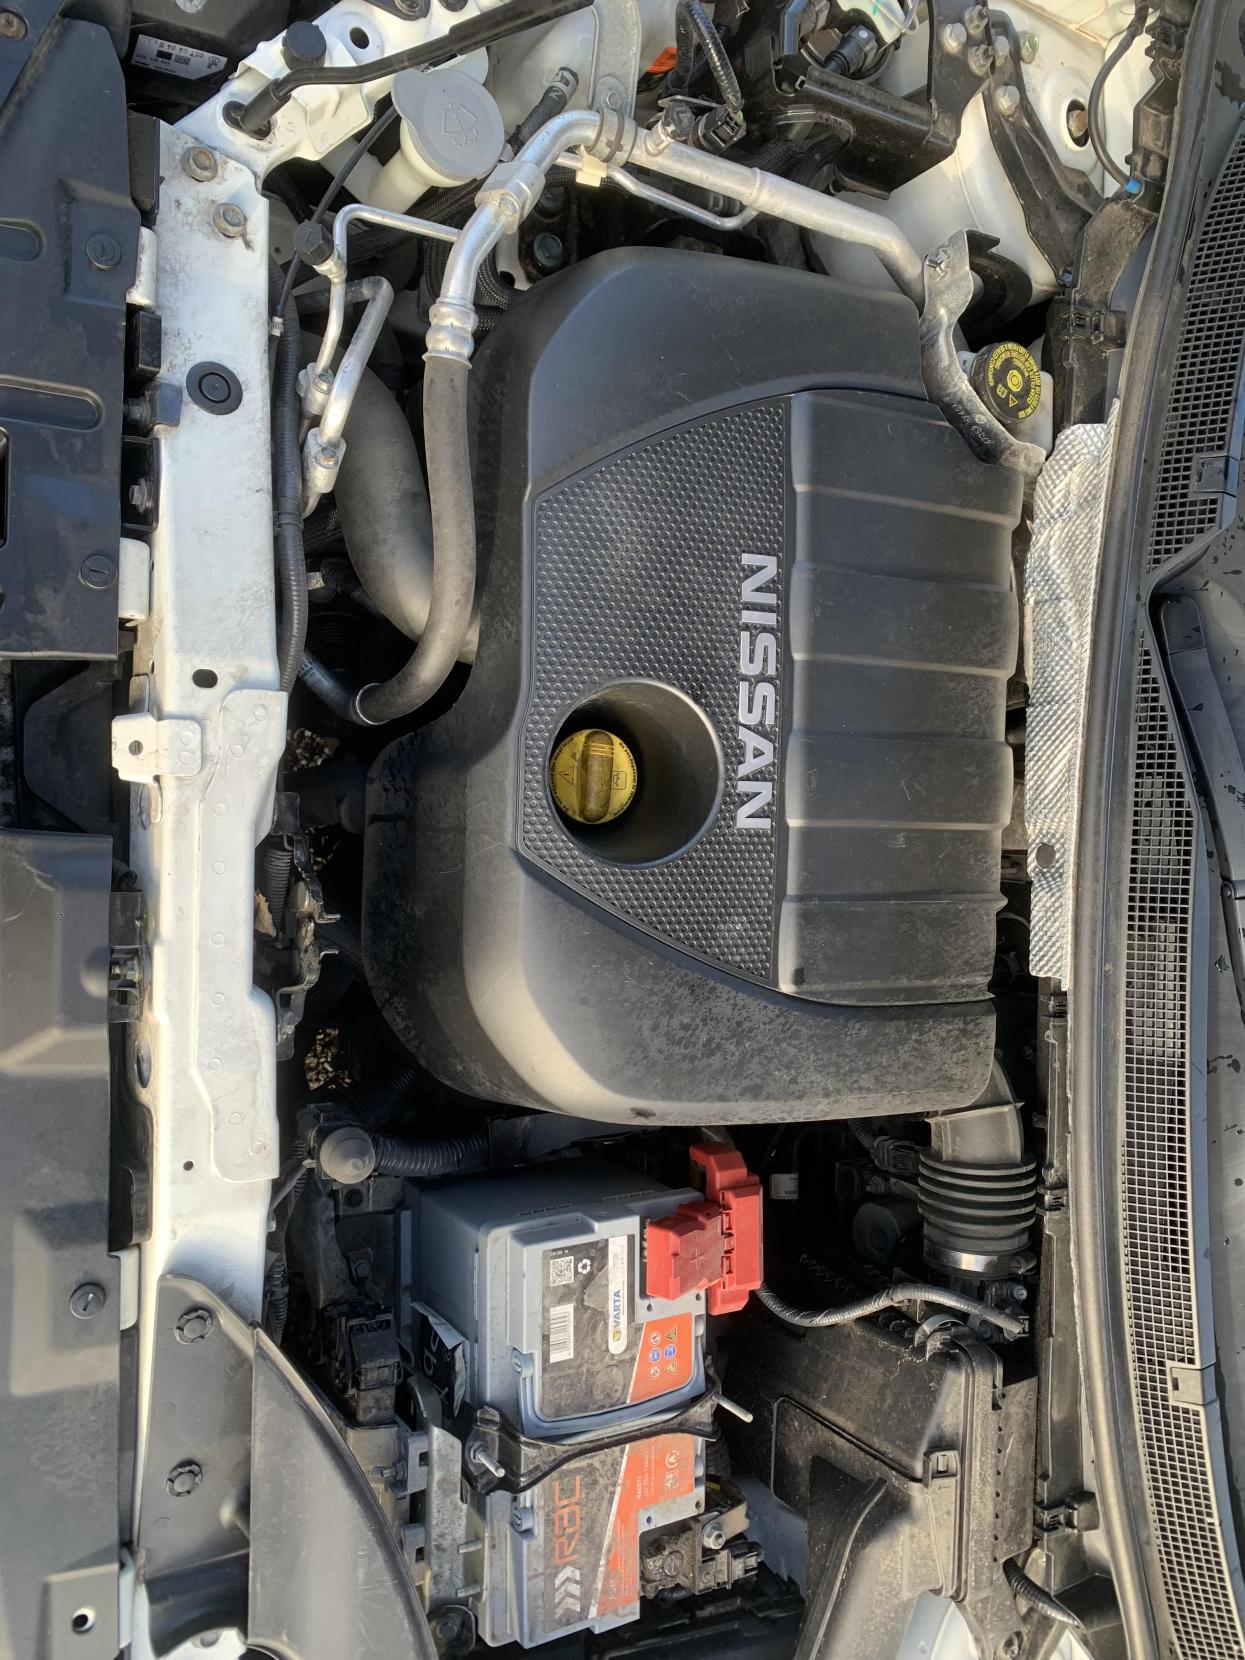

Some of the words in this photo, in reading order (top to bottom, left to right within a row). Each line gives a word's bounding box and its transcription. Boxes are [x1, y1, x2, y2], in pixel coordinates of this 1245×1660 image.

[736, 553, 778, 829] NISSAN
[612, 1289, 621, 1330] VARTA
[554, 1473, 581, 1566] RAC
